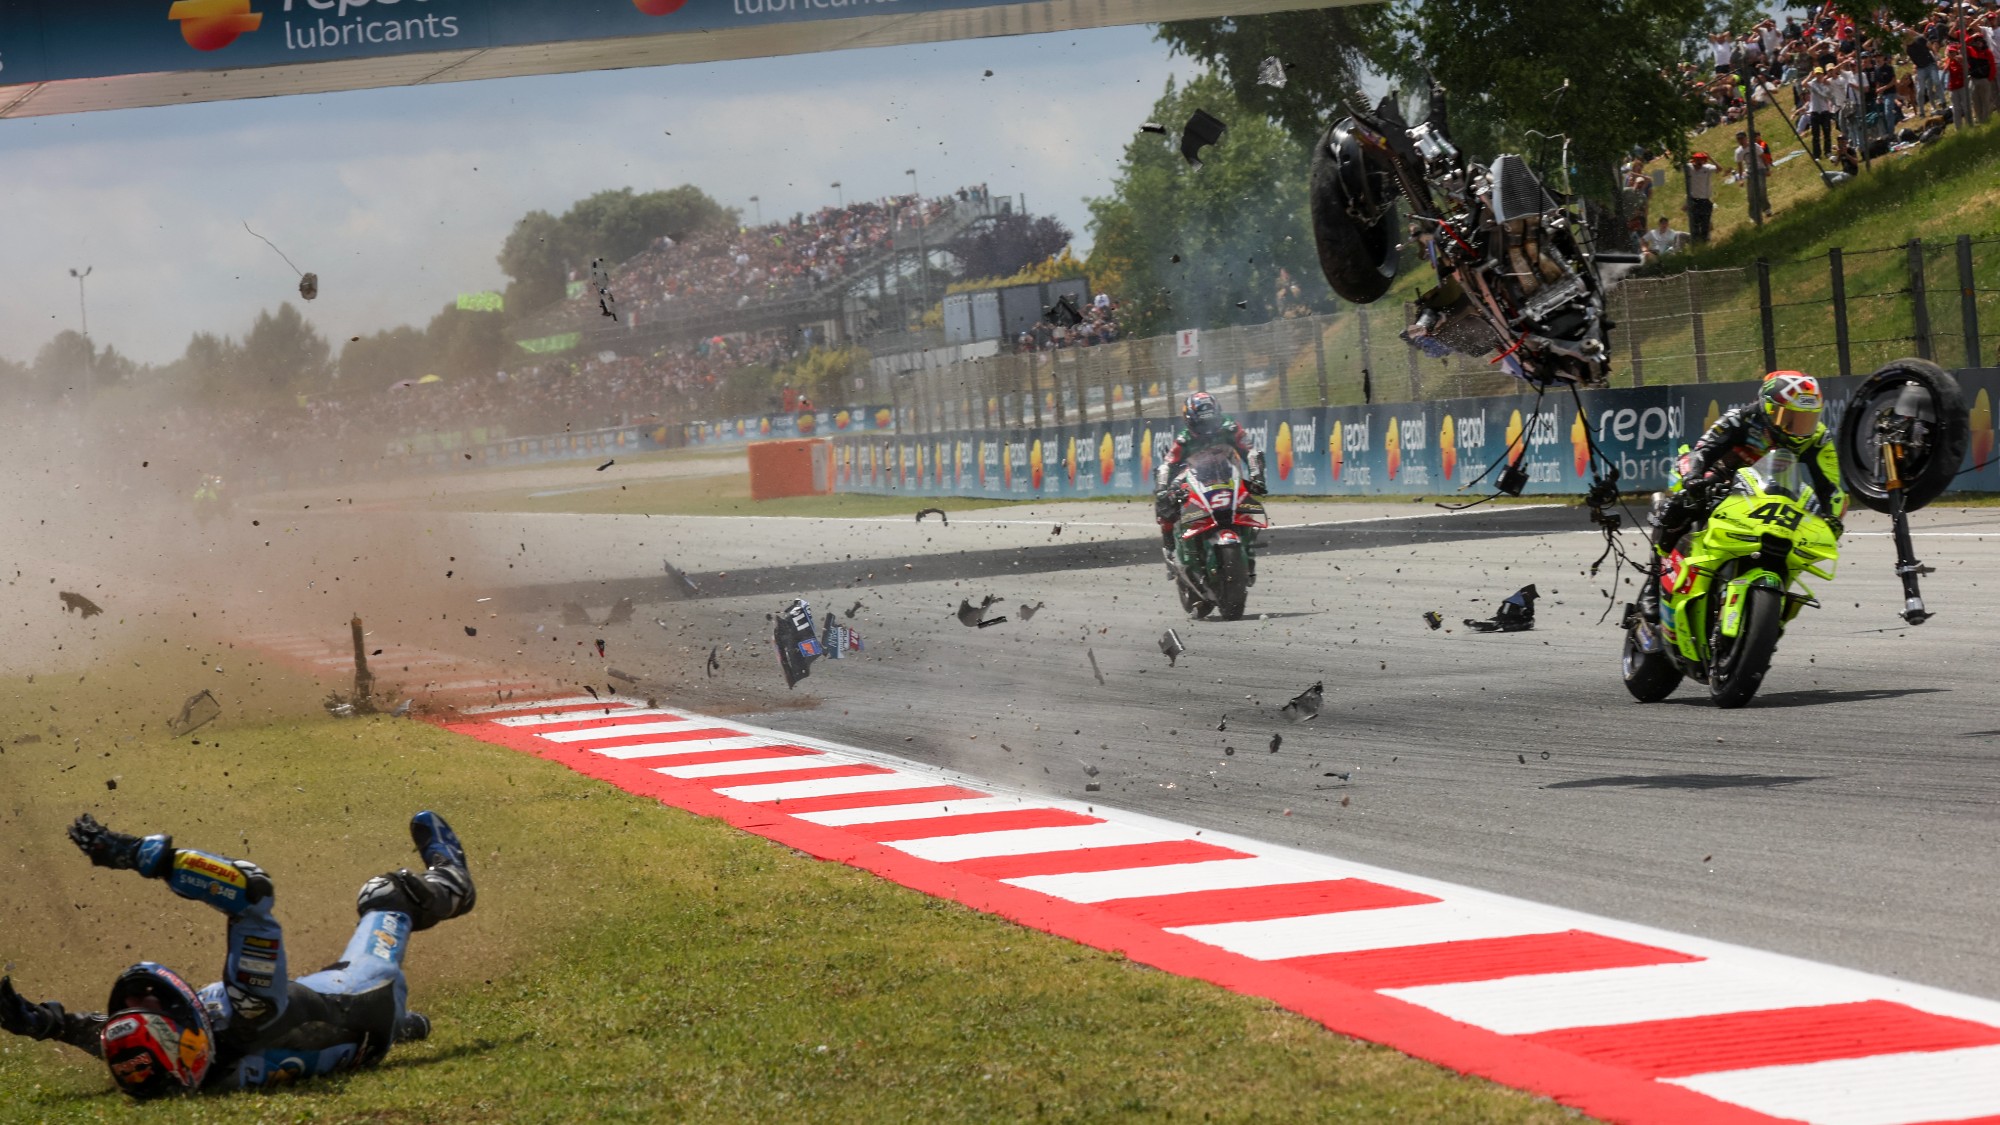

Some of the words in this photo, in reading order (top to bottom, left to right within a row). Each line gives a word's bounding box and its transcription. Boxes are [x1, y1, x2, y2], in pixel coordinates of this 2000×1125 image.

[285, 13, 459, 49] lubricants
[1457, 408, 1486, 456] repsol
[1525, 404, 1558, 453] repsol
[1599, 396, 1685, 450] repsol
[1747, 502, 1804, 531] 49
[180, 873, 209, 890] NEWS
[183, 857, 240, 883] Antangin
